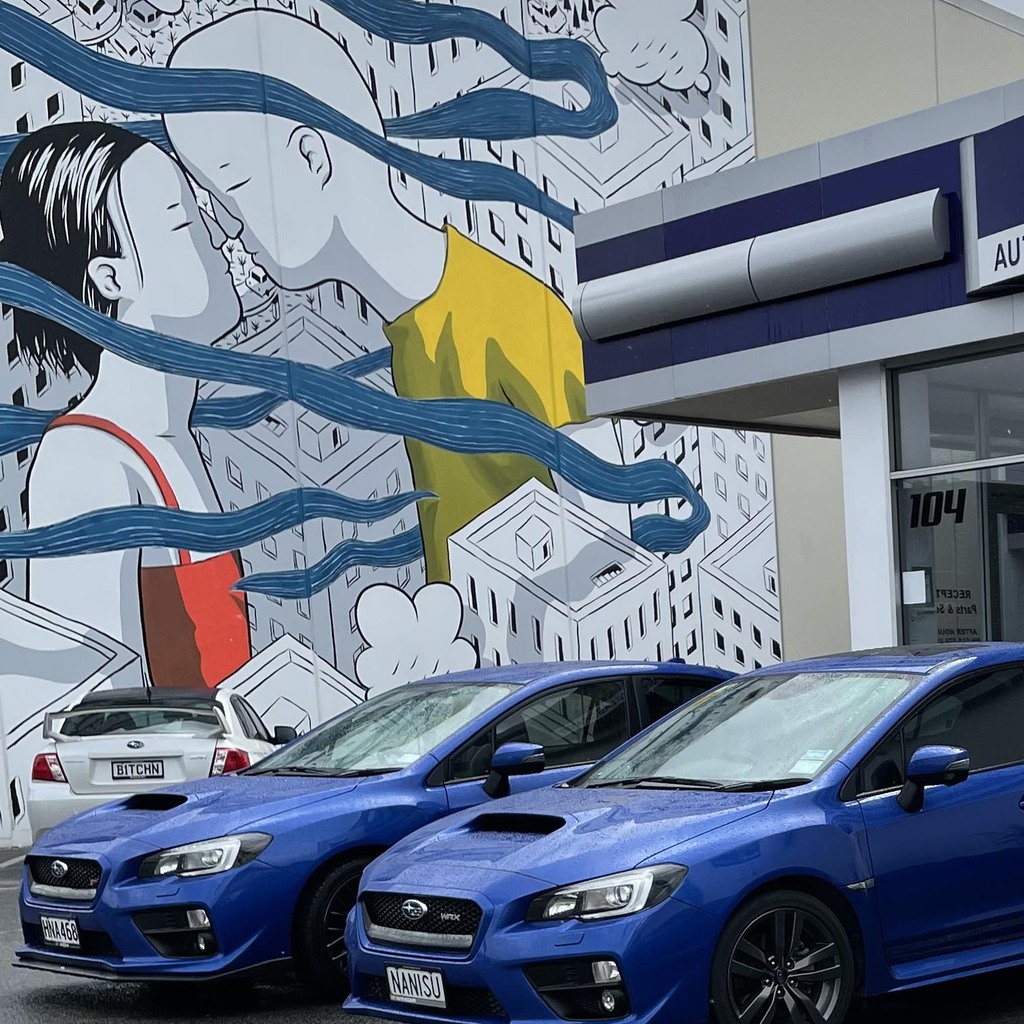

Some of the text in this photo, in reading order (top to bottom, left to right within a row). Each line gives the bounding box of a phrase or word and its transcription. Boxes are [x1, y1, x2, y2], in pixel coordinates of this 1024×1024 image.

[909, 488, 967, 529] 104
[116, 763, 160, 776] BITCHN
[440, 912, 460, 921] WRX
[41, 919, 79, 942] HNA468
[390, 970, 441, 998] NANISU
